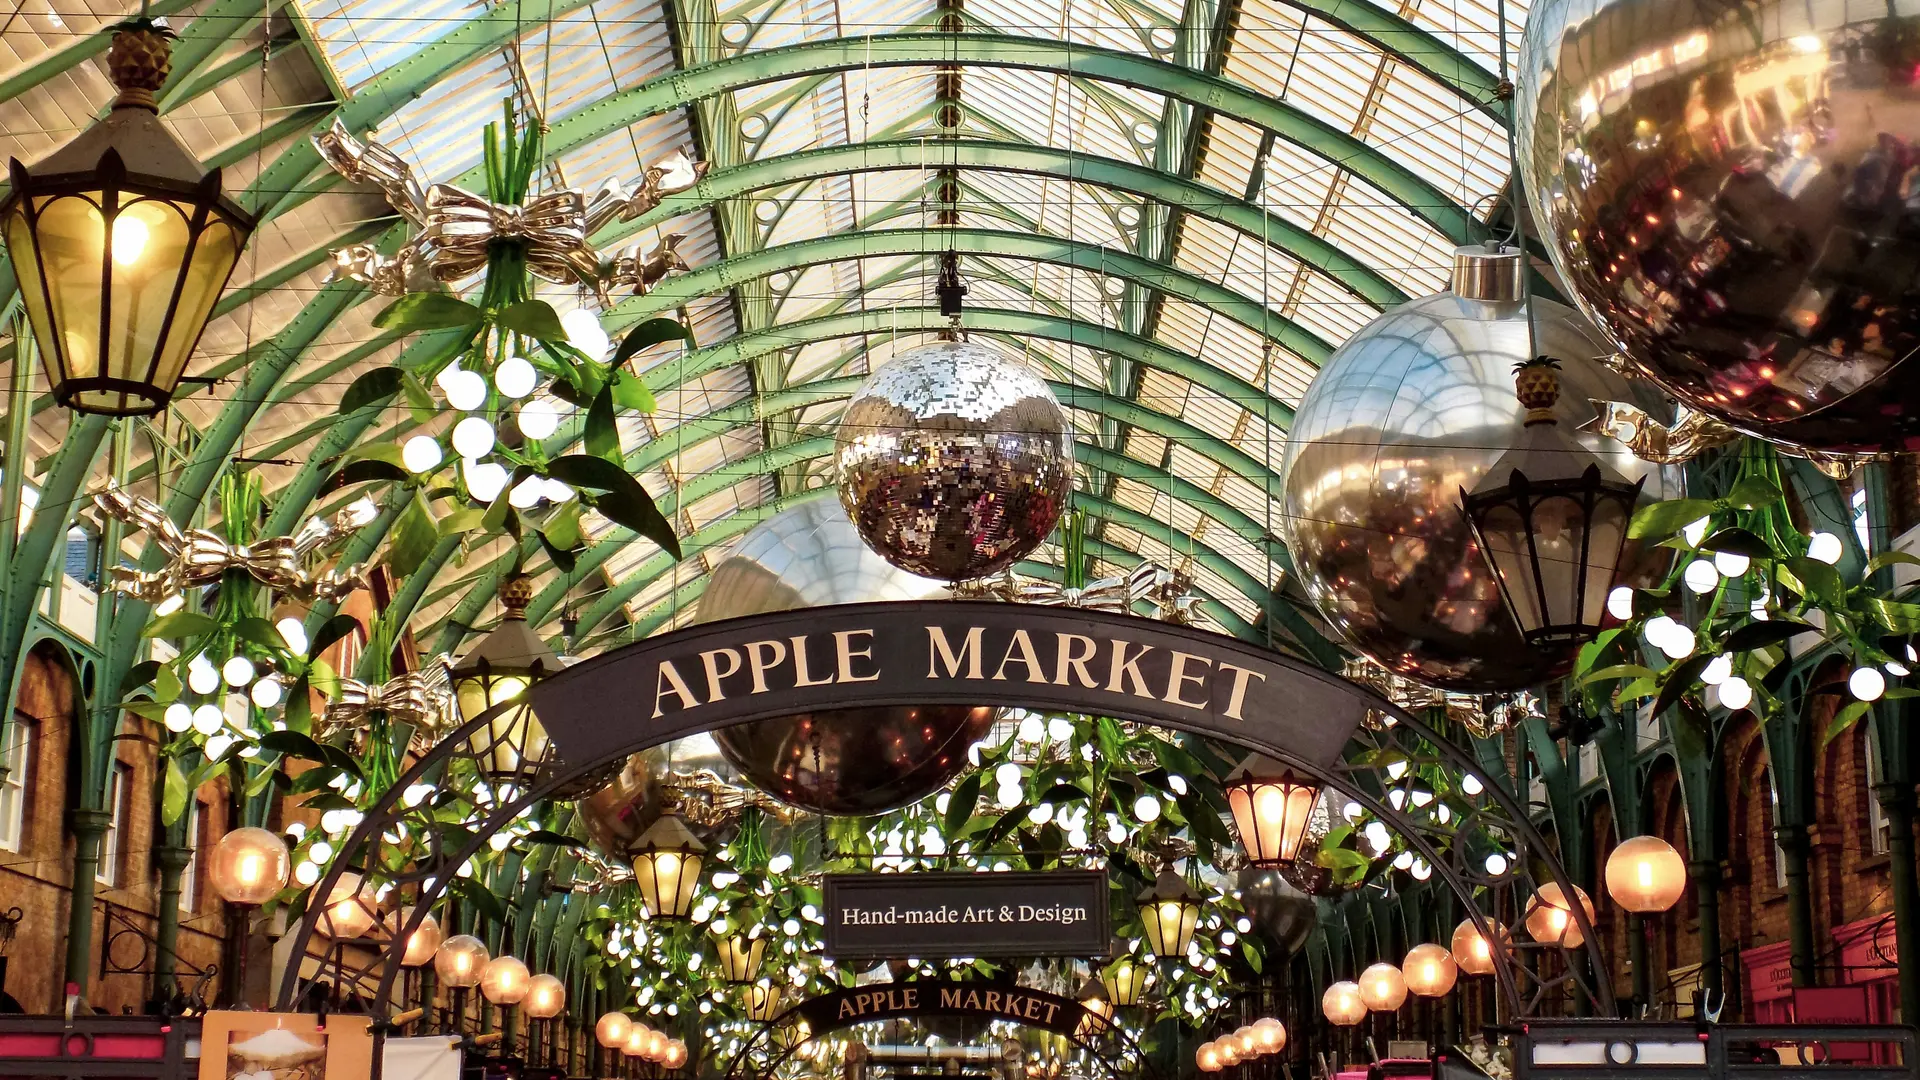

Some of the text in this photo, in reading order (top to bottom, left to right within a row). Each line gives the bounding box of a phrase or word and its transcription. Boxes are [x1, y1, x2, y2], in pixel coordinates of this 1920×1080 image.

[651, 626, 1267, 721] APPLE MARKET
[841, 903, 1087, 925] Hand-made Art & Design
[838, 988, 1061, 1025] APPLE MARKET
